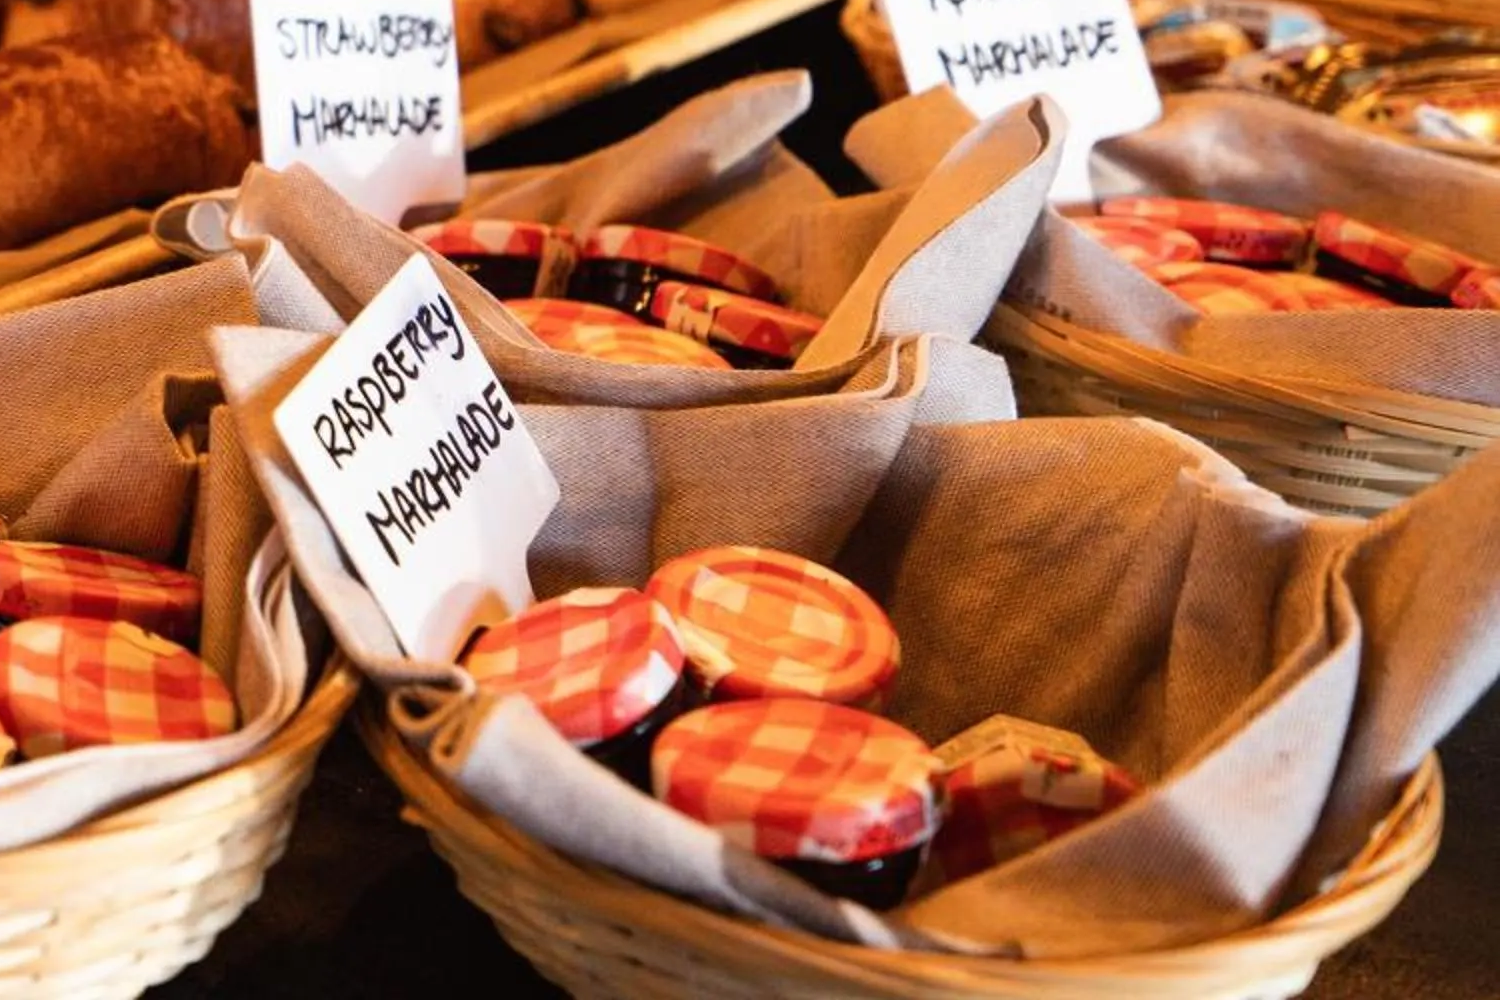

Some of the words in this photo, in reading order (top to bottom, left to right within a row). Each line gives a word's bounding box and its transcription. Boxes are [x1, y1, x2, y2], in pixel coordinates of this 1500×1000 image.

[936, 19, 1120, 88] MARMALADE
[291, 94, 444, 148] MARMALADE
[312, 293, 466, 470] RASPBERRY
[365, 381, 515, 567] MARMALADE
